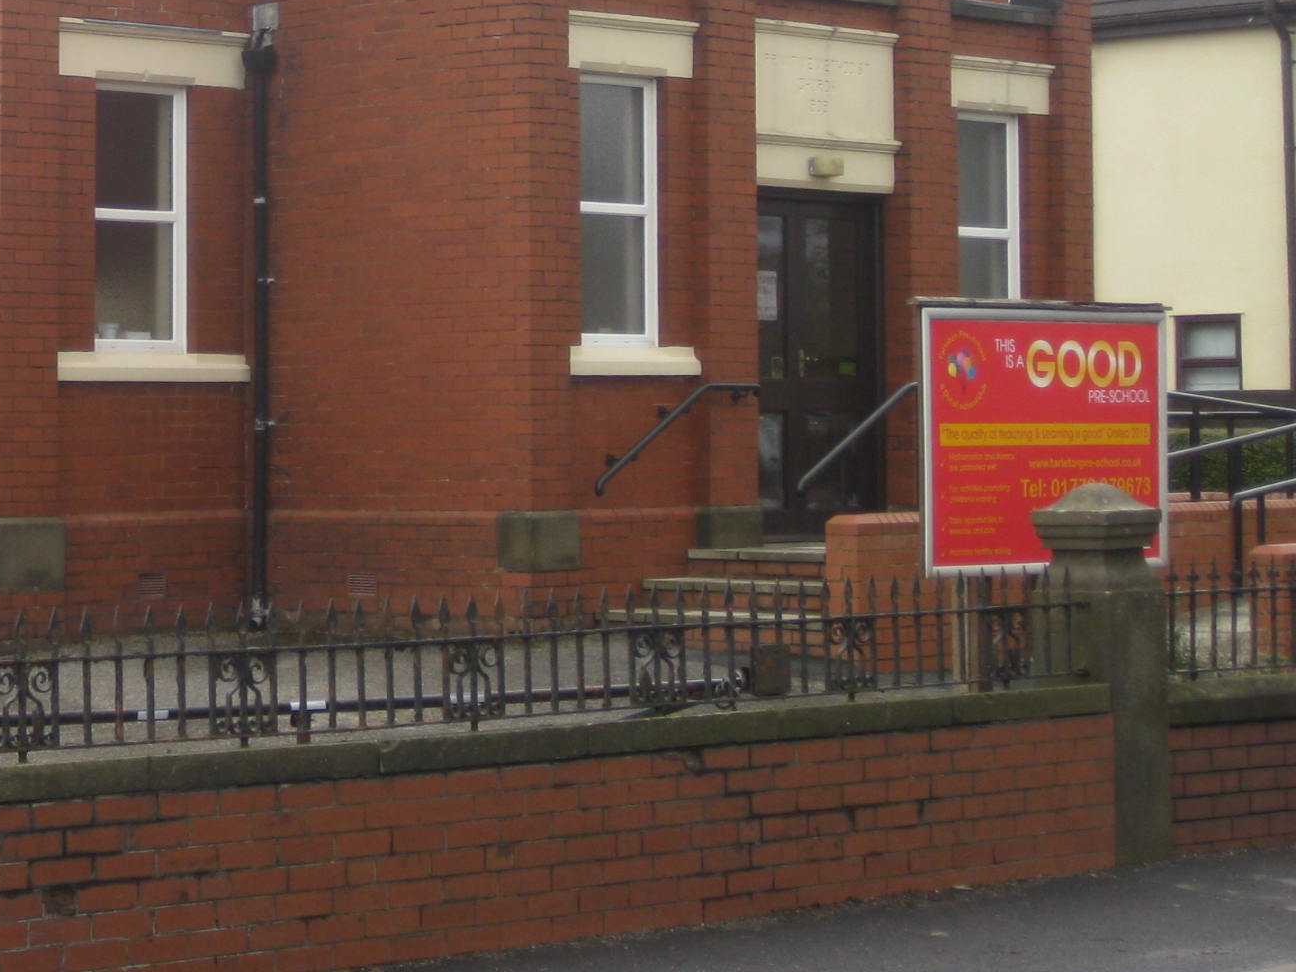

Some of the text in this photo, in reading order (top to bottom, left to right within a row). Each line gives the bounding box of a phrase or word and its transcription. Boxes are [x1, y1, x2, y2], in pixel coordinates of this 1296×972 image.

[994, 338, 1016, 353] THIS
[1005, 354, 1025, 369] IS A
[1026, 339, 1142, 388] GOOD
[1088, 389, 1151, 403] PRE-SCHOOL
[1019, 478, 1047, 497] Tel:
